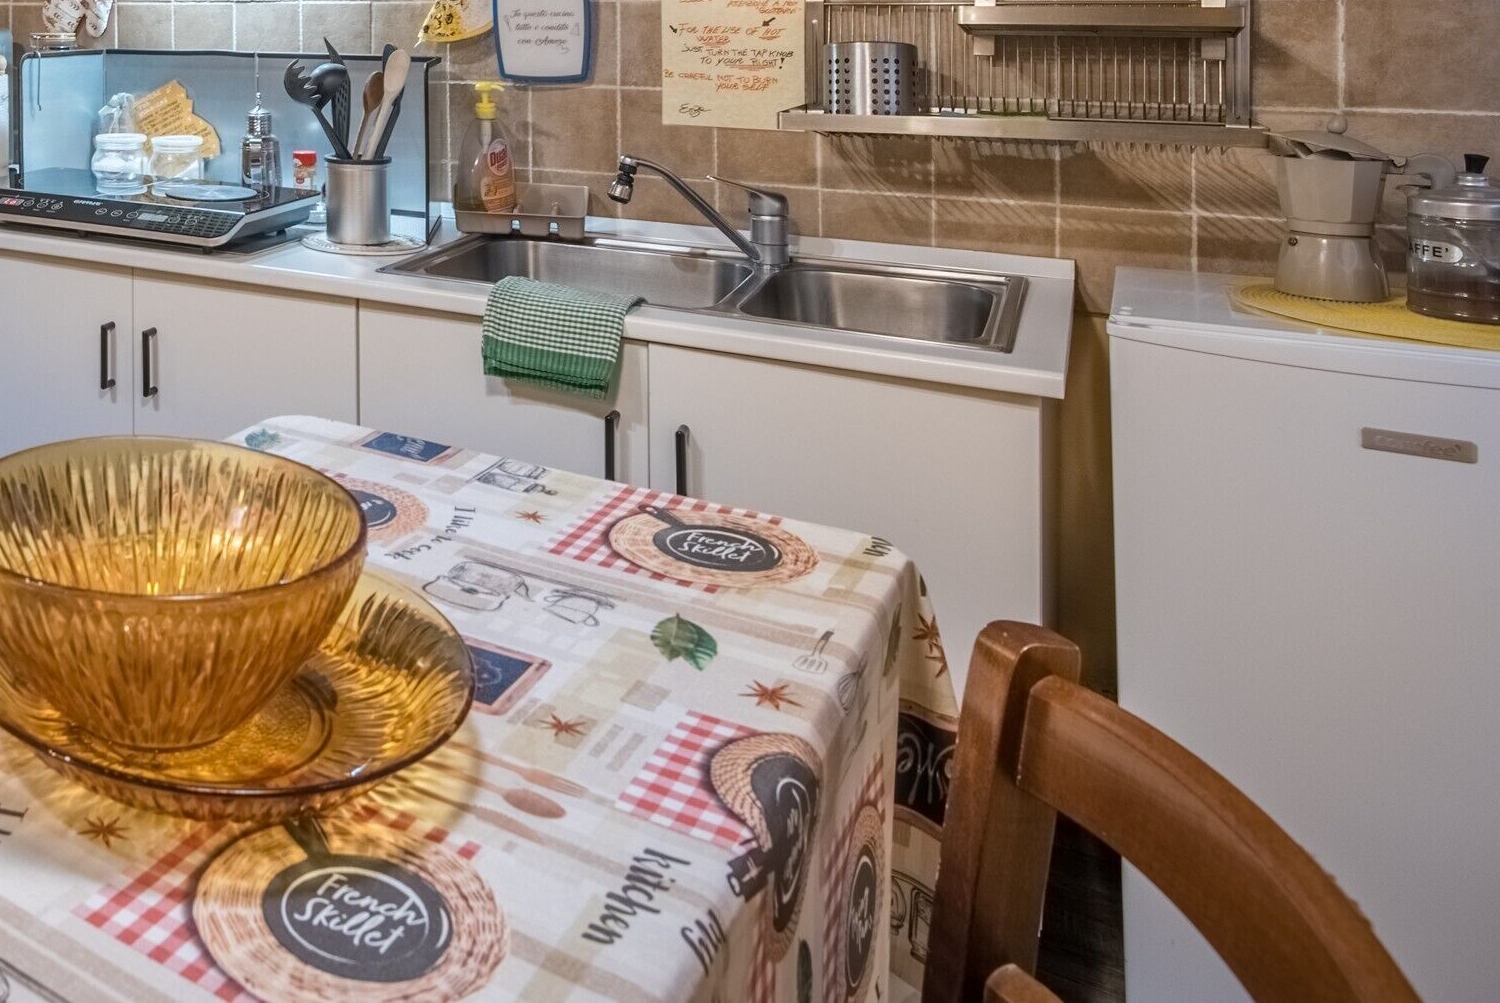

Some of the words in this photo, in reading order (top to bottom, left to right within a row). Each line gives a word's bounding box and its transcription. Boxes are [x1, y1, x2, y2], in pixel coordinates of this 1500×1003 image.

[702, 26, 721, 35] THE
[721, 26, 741, 35] USE
[745, 26, 761, 36] OF
[762, 28, 786, 36] HOT
[700, 56, 712, 65] TO
[715, 56, 744, 67] YOUR
[706, 48, 729, 57] TURN
[731, 48, 748, 57] THE
[750, 48, 768, 58] TAP
[768, 49, 794, 58] KNOB
[739, 76, 750, 84] TO
[1408, 242, 1450, 258] AFFE'
[686, 531, 763, 551] French
[677, 541, 752, 563] Skillet
[315, 872, 431, 928] French
[581, 846, 692, 947] kitchen
[293, 897, 406, 955] Skillet
